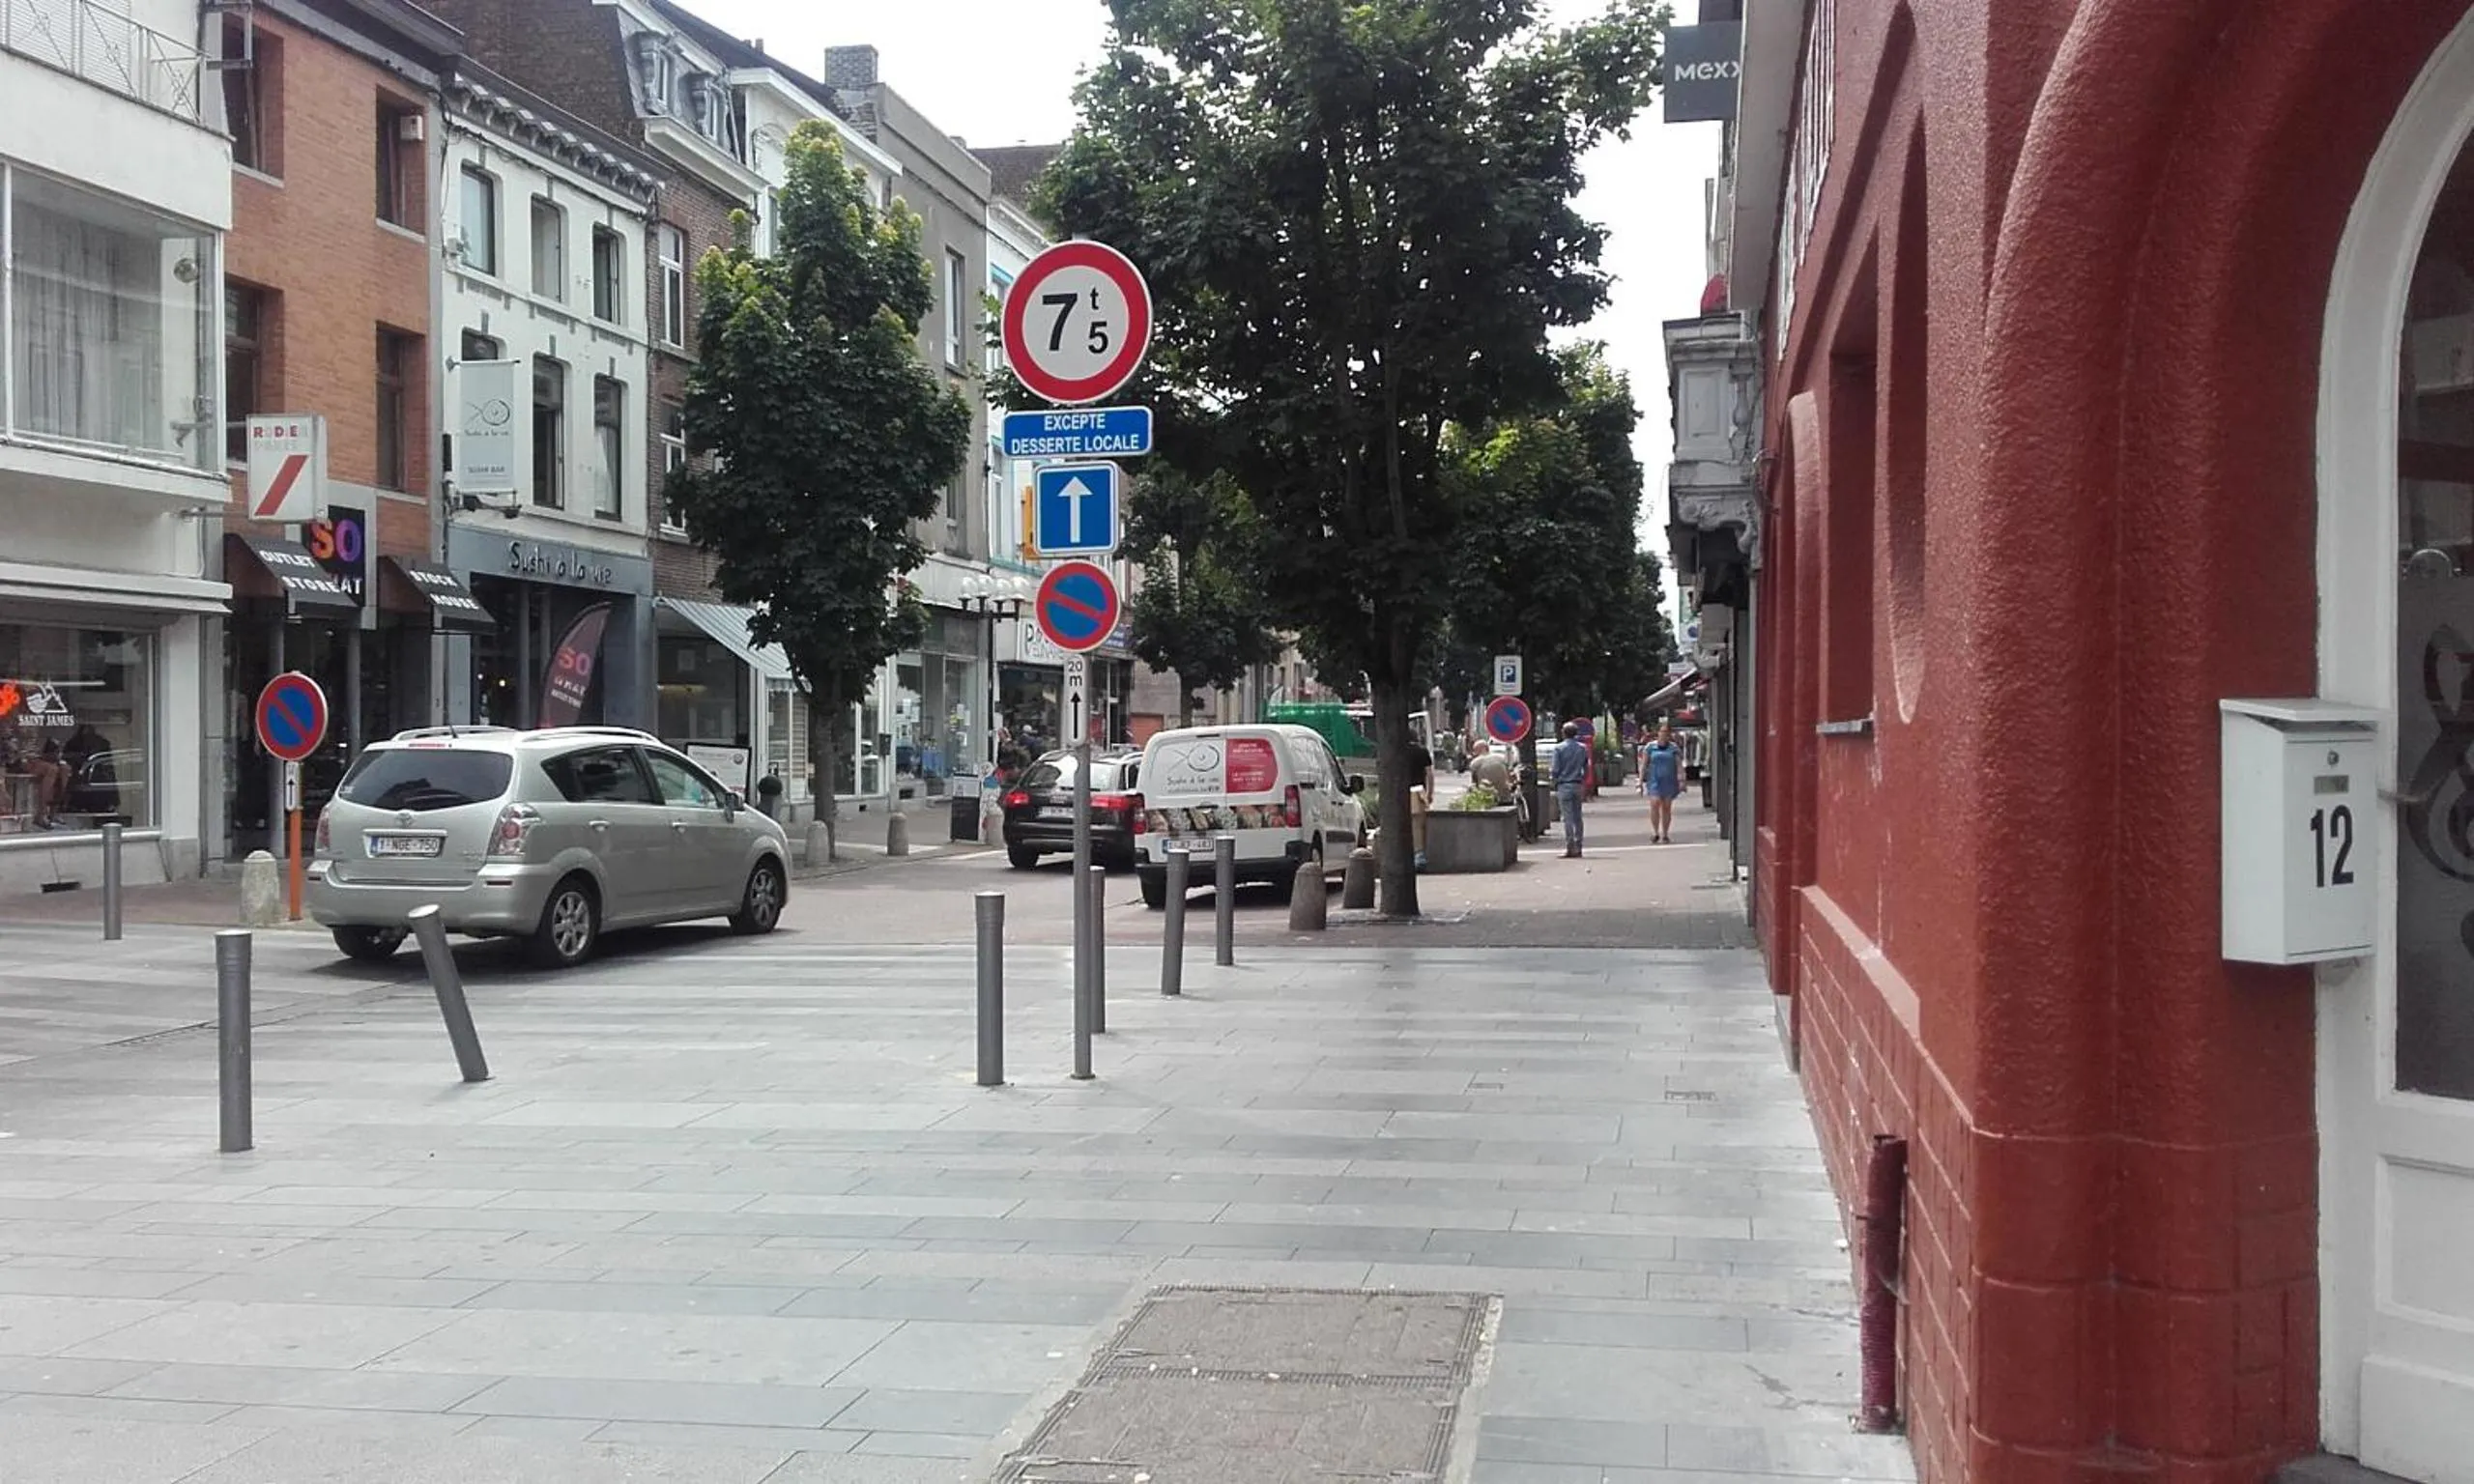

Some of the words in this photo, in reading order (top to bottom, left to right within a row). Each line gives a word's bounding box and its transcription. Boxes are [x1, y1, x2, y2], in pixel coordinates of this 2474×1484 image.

[1089, 287, 1100, 311] t
[1042, 293, 1079, 353] 7
[1088, 321, 1109, 354] 5
[1044, 413, 1107, 432] EXCEPTE
[1011, 436, 1081, 455] DESSERTE
[1084, 434, 1140, 452] LOCALE
[310, 517, 362, 562] SO
[259, 549, 316, 568] OUTLET
[508, 540, 551, 575] Sushi
[281, 576, 341, 593] STORE
[409, 569, 458, 587] STOCK
[429, 592, 480, 610] HOUSE
[559, 646, 591, 676] SO
[1068, 660, 1082, 672] 20
[1069, 675, 1082, 687] m
[1503, 666, 1514, 682] P
[18, 714, 44, 727] SAINT
[46, 714, 75, 727] JAMES
[2310, 804, 2354, 888] 12
